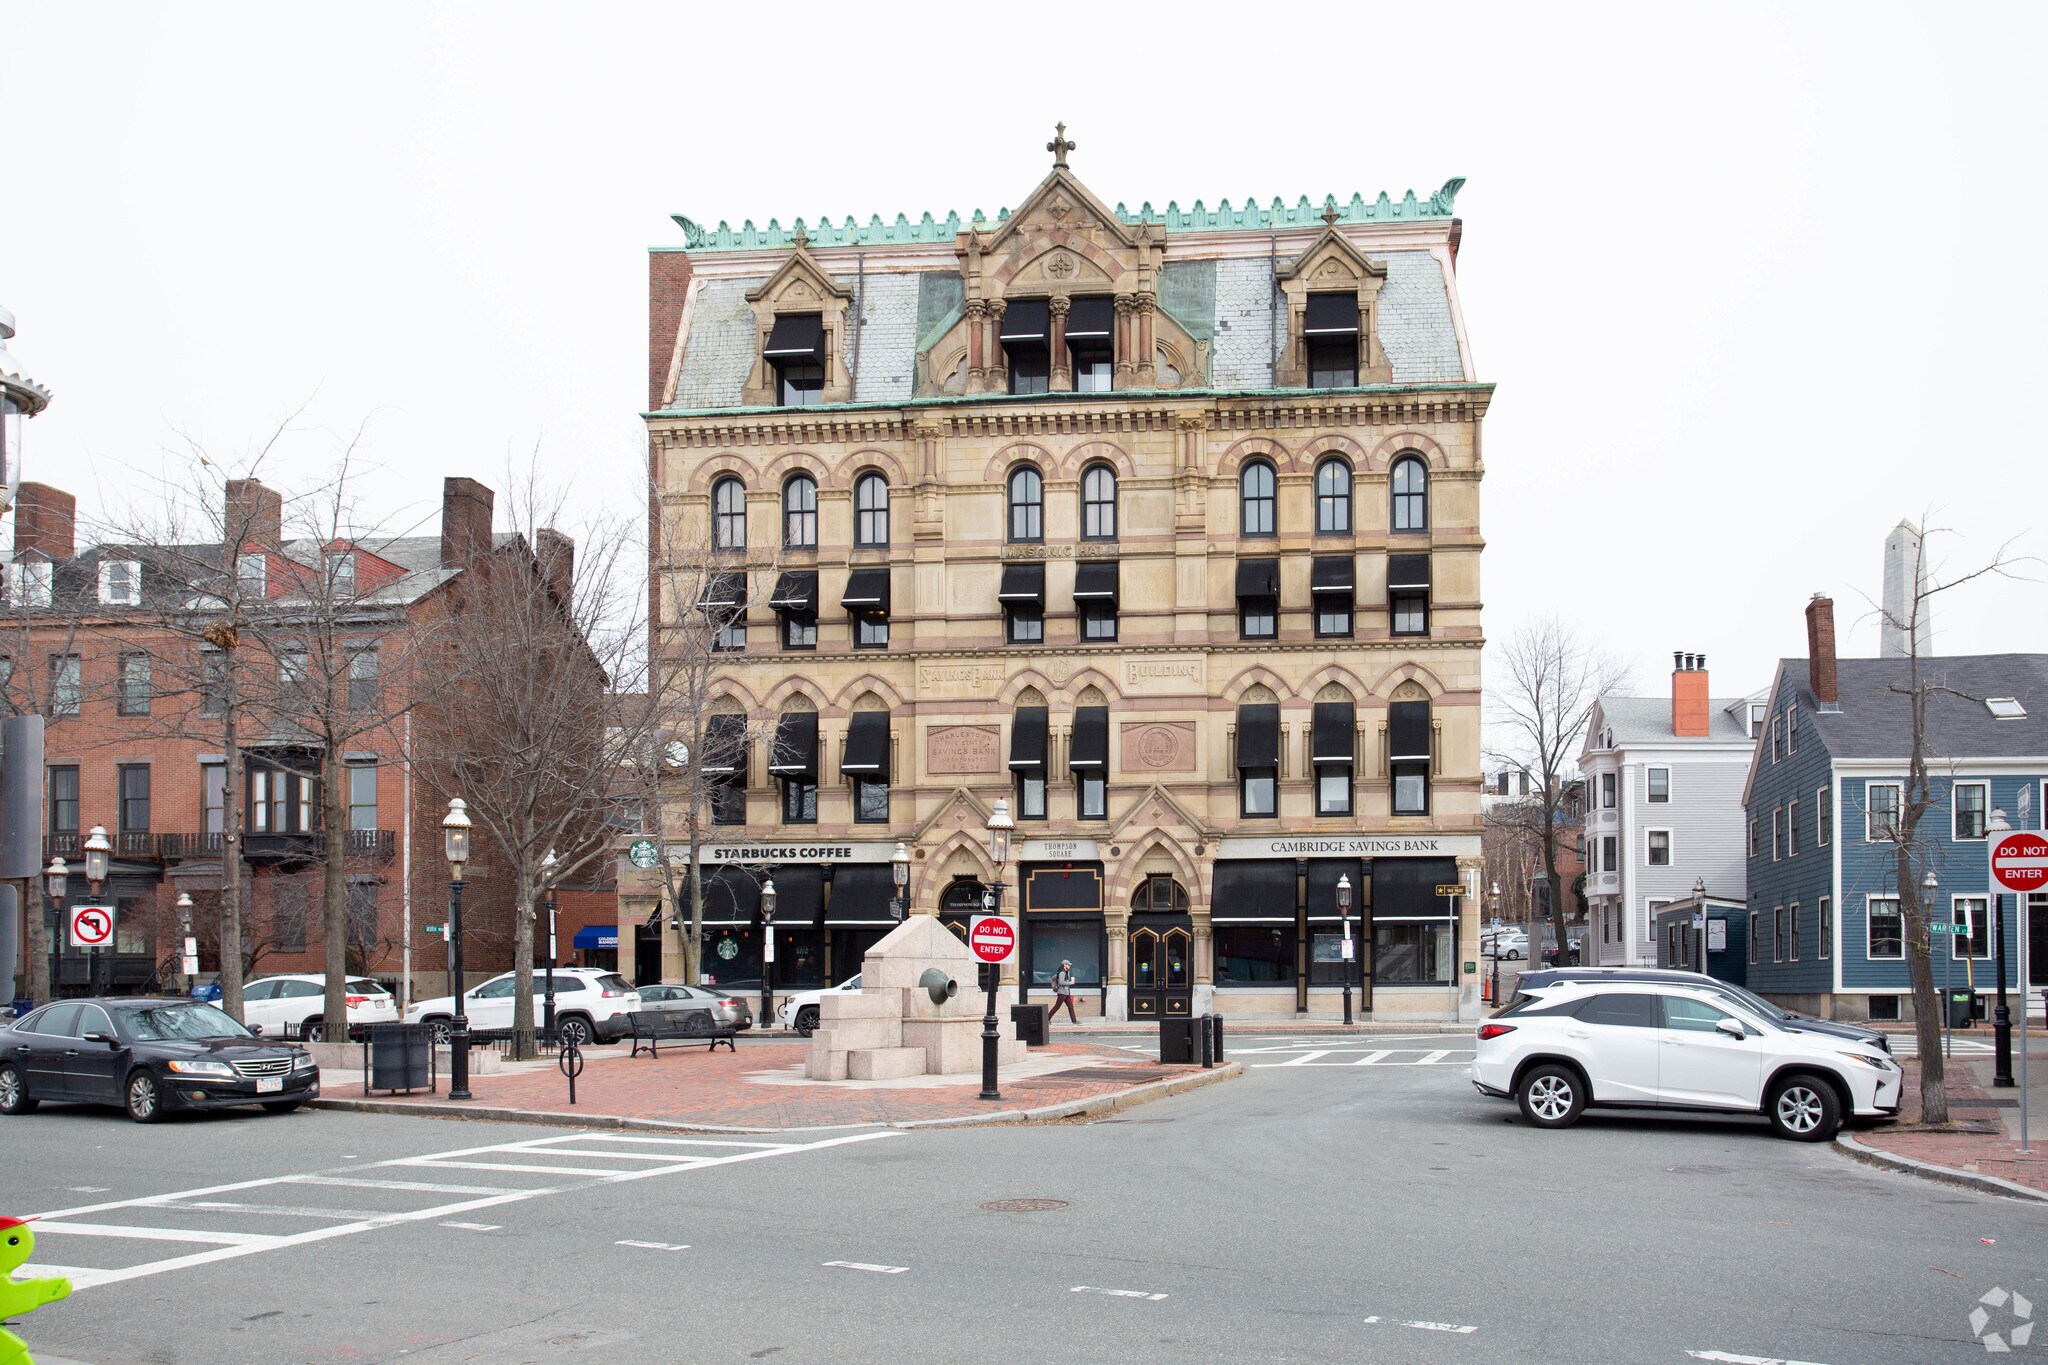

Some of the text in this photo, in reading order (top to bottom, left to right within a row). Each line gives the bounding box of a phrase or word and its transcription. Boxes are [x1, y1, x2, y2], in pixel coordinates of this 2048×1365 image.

[1006, 545, 1117, 558] MASONIC HALL
[920, 666, 1005, 689] SAVINGS BANK
[1128, 663, 1199, 685] BUILDING
[935, 732, 993, 742] CHARLESTOWN
[932, 748, 968, 756] SAVINGS
[1271, 840, 1439, 852] CAMBRIDGE SAVINGS BANK
[2000, 846, 2047, 856] DO NOT
[714, 847, 852, 859] STARBUCKS COFFEE
[1049, 850, 1072, 858] SQUARE
[2005, 869, 2043, 879] ENTER
[992, 927, 1008, 935] NOT
[980, 945, 1005, 954] ENTER
